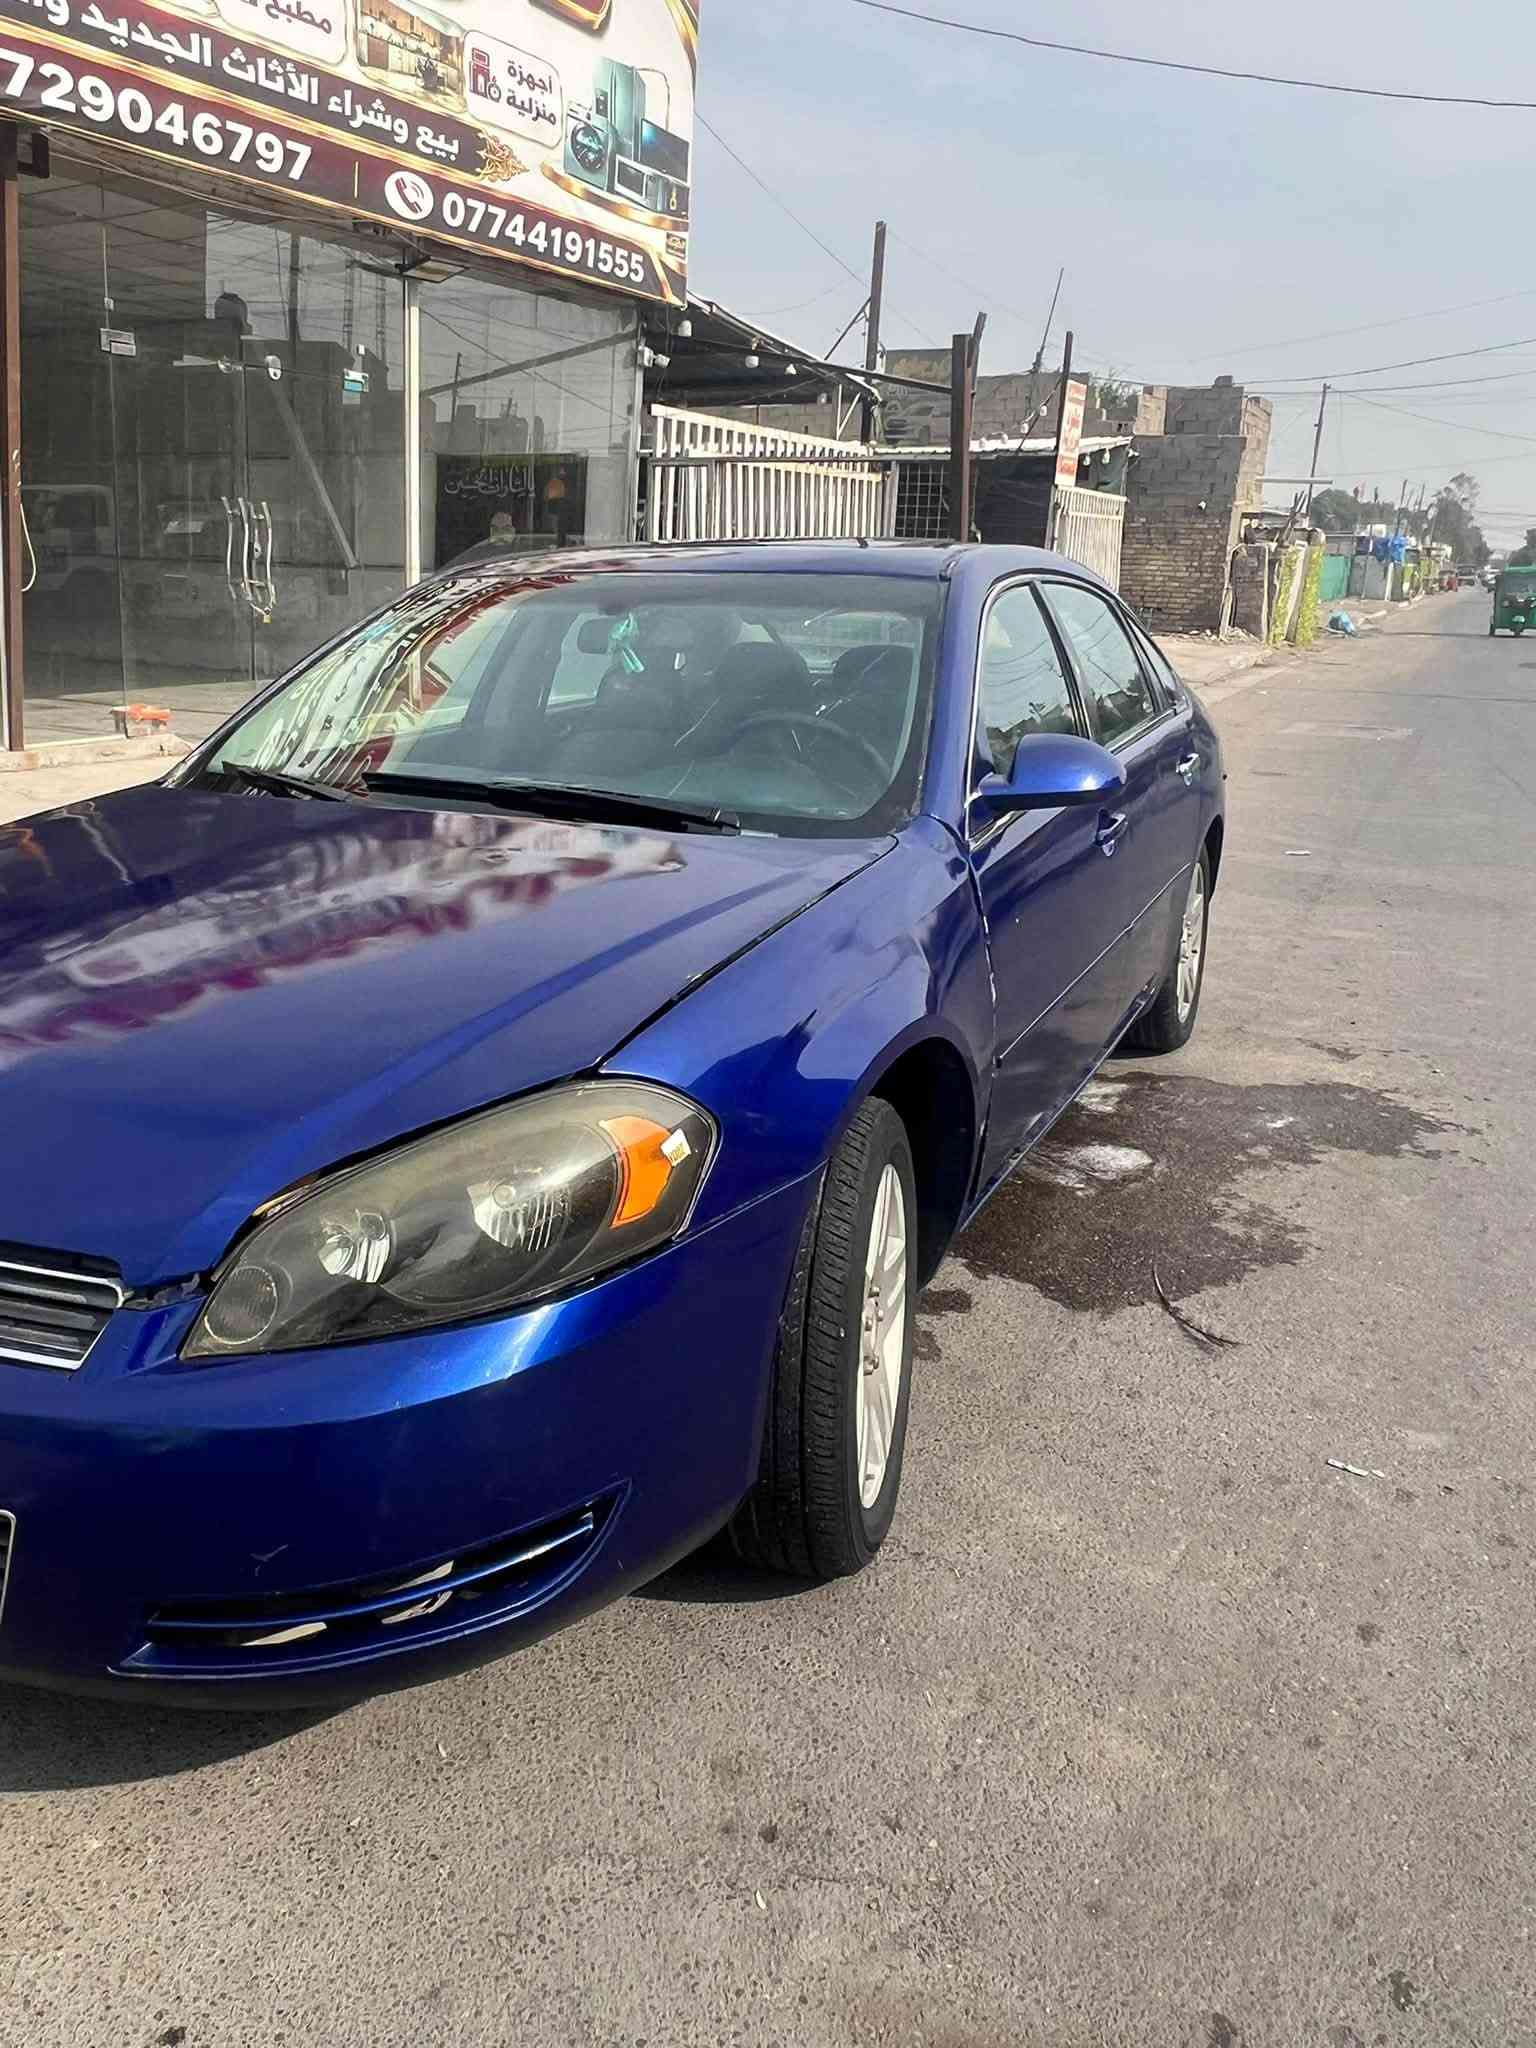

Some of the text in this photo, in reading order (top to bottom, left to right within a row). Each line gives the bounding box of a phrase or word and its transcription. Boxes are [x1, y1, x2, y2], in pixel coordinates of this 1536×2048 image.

[81, 2, 213, 67] الجديد
[221, 47, 319, 105] الأثاث
[327, 89, 409, 144] وشراء
[506, 88, 557, 126] منزلية
[415, 125, 460, 161] بيع
[442, 192, 645, 283] 07744191555
